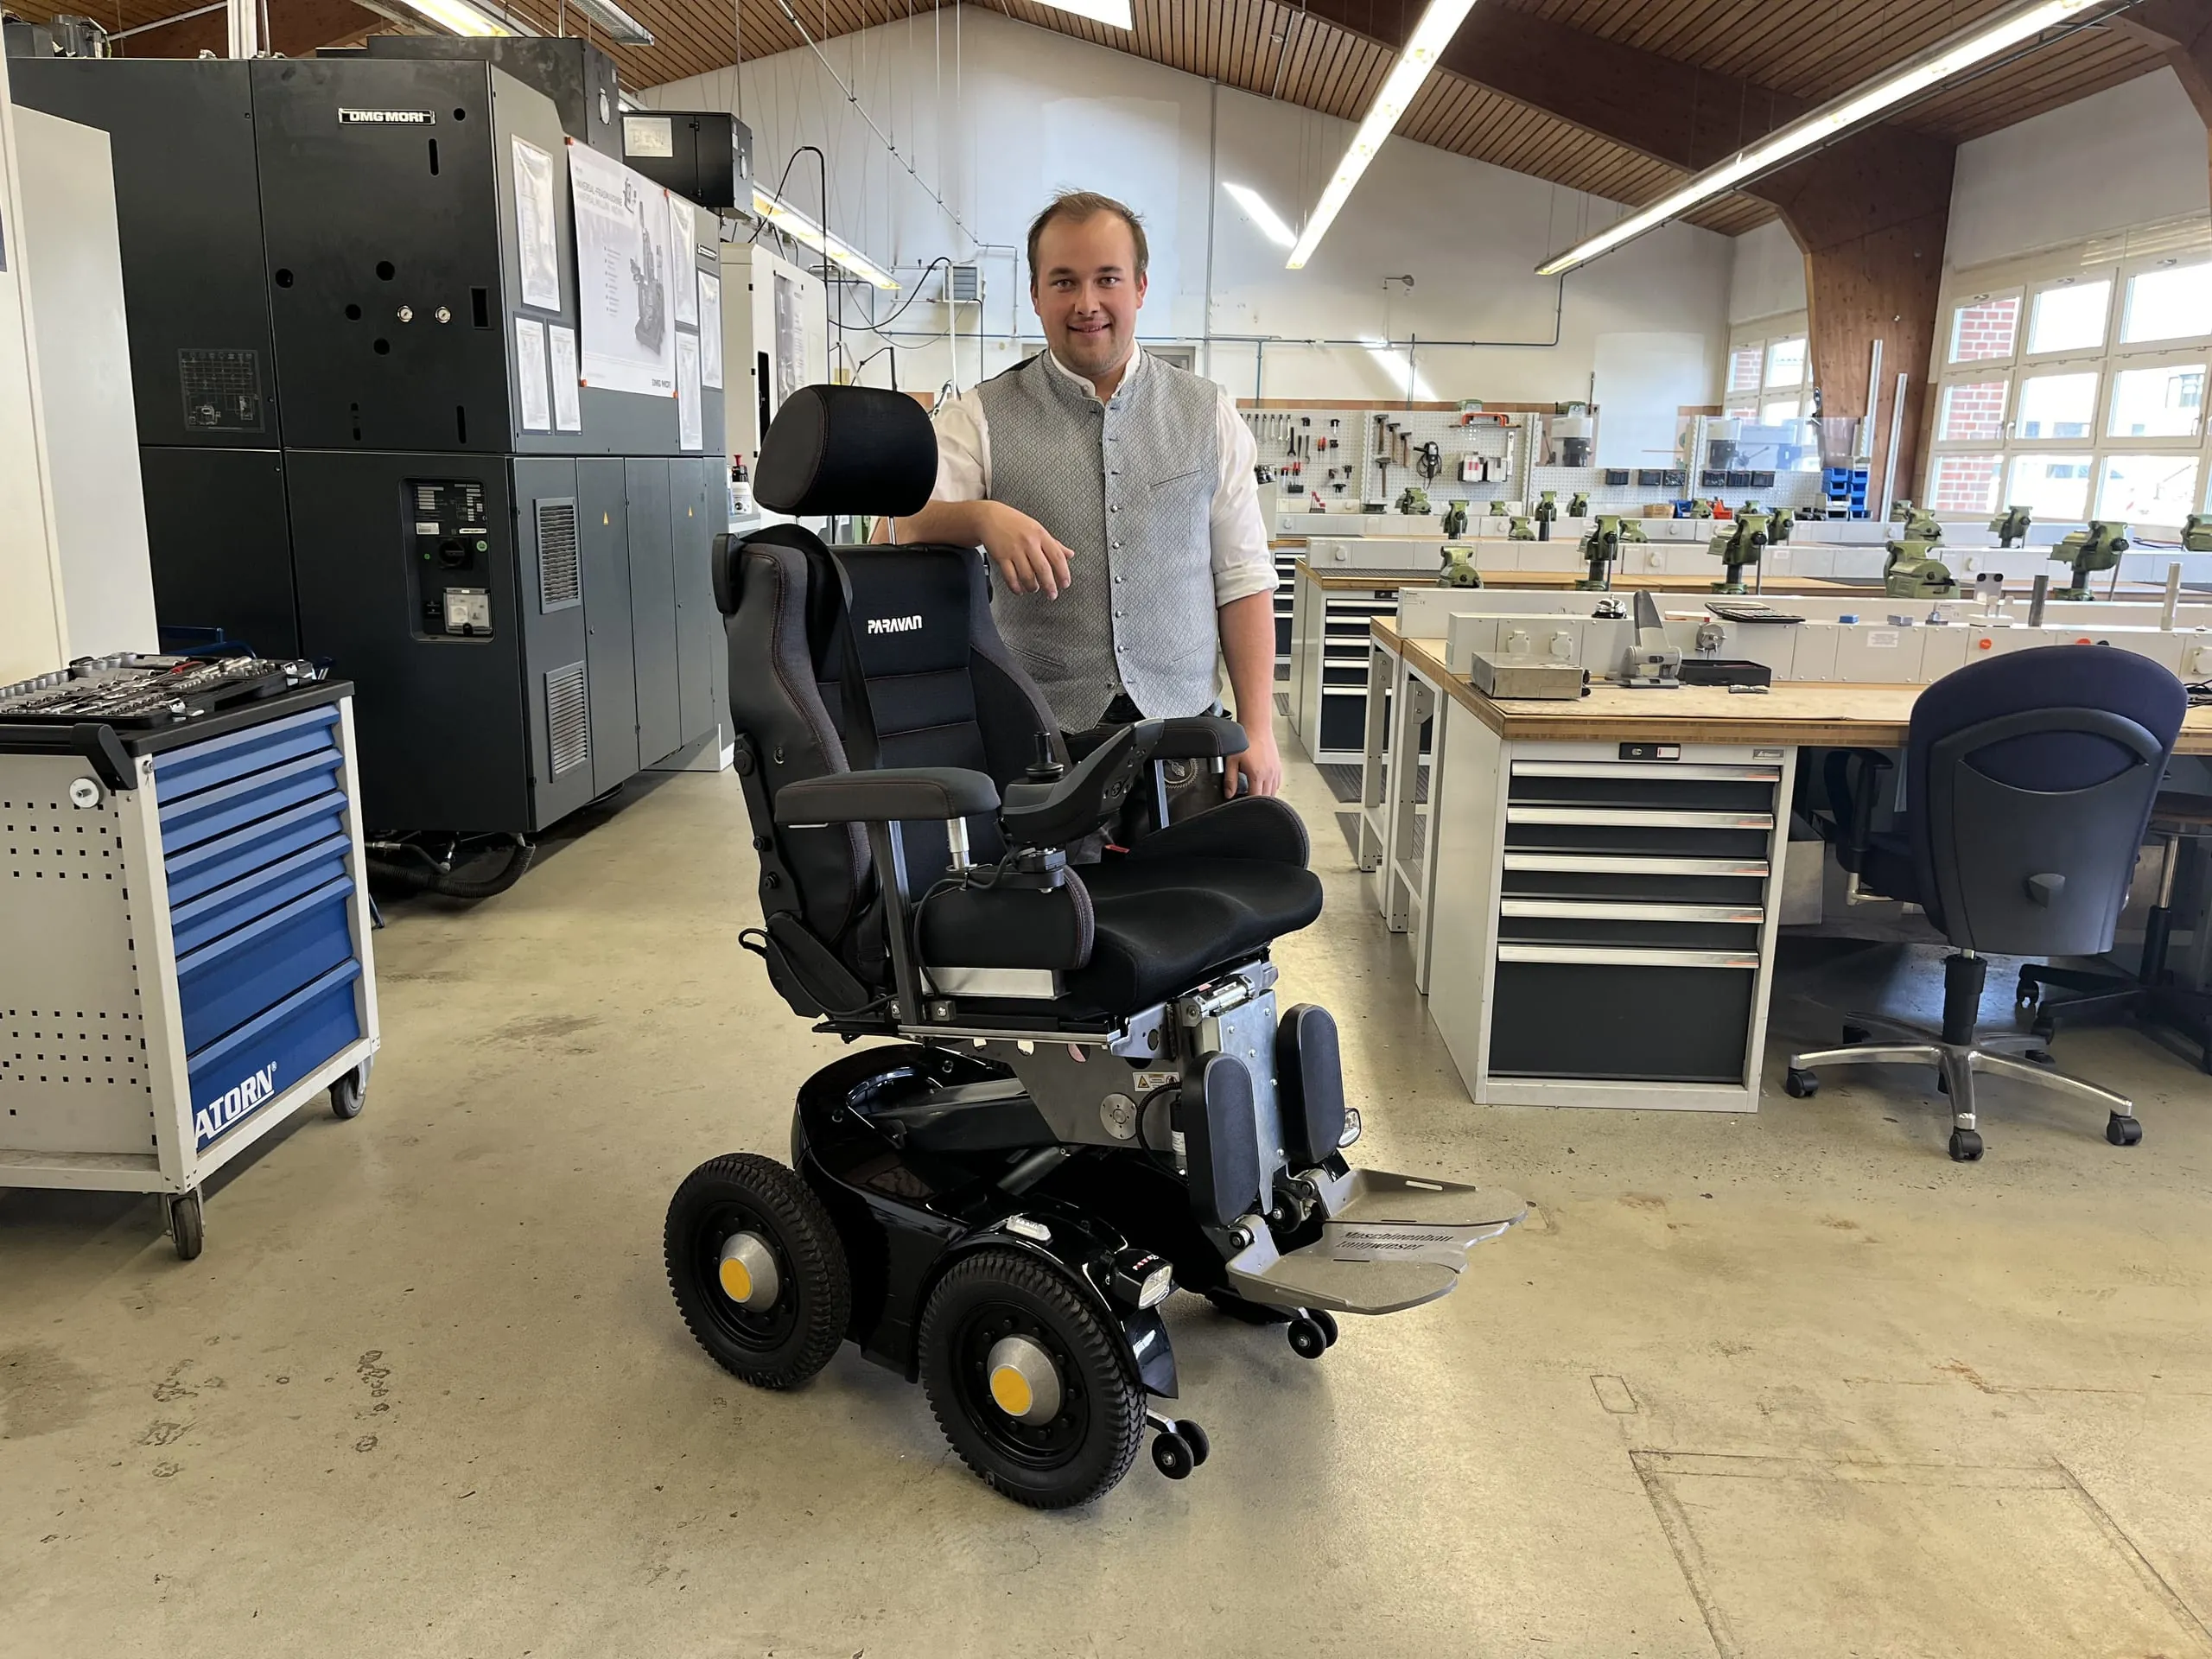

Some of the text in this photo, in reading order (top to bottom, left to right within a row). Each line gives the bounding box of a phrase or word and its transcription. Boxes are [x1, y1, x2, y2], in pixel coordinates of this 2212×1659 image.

[349, 111, 424, 122] DMG MORI
[868, 614, 923, 634] PARAVAN
[1342, 1230, 1454, 1243] Maschinenbau
[1336, 1240, 1425, 1251] Langwieser
